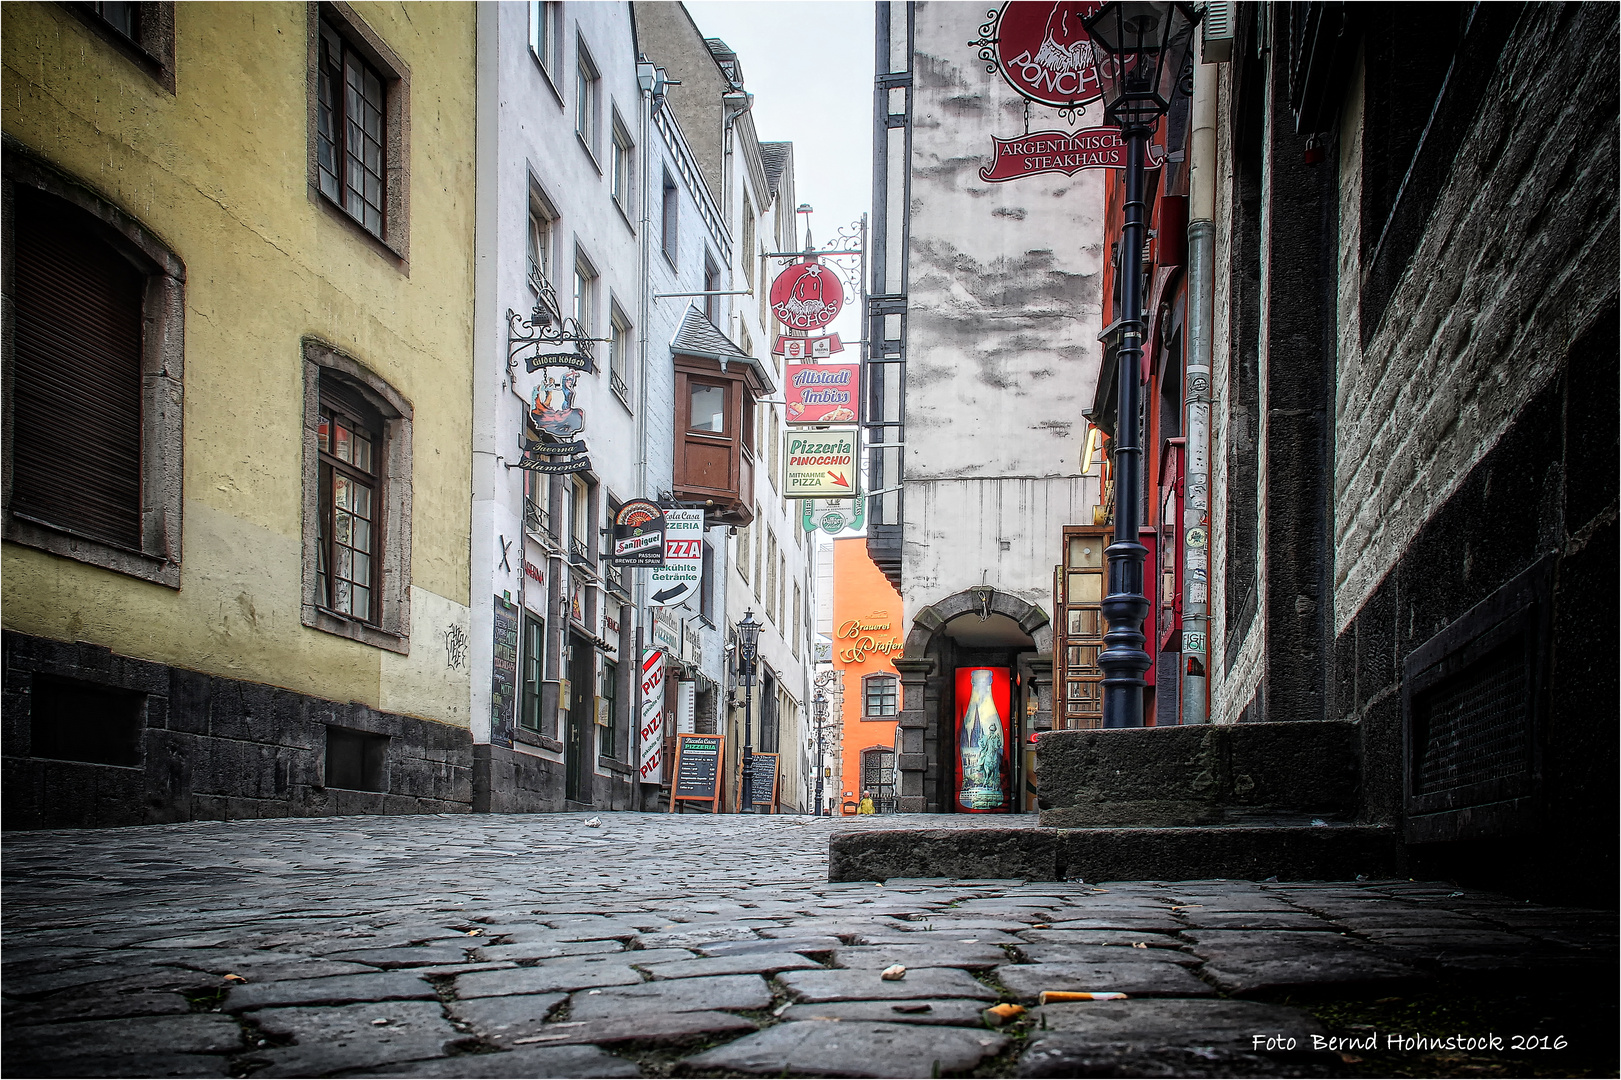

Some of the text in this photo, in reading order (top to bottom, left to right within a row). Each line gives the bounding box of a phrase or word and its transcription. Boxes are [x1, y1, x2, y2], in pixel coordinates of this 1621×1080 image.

[1001, 134, 1127, 157] ARGENTINISCH
[1024, 150, 1119, 170] STEAKHAUS
[532, 356, 557, 367] Gilden
[793, 369, 850, 387] Altstadt
[801, 388, 849, 404] Imbiss
[532, 443, 577, 452] Taverna
[790, 439, 851, 454] Pizzeria
[521, 460, 587, 472] Flamenca
[789, 455, 851, 466] PINOCCHIO
[792, 478, 822, 486] PIZZA
[666, 511, 700, 520] cola Casa
[667, 541, 701, 557] ZZA
[652, 573, 698, 581] Getränke
[837, 619, 891, 639] Brauerei
[840, 635, 904, 663] Pfaffen
[641, 665, 665, 695] PIZZ
[640, 706, 664, 741] PIZZ
[640, 743, 663, 779] PIZZ
